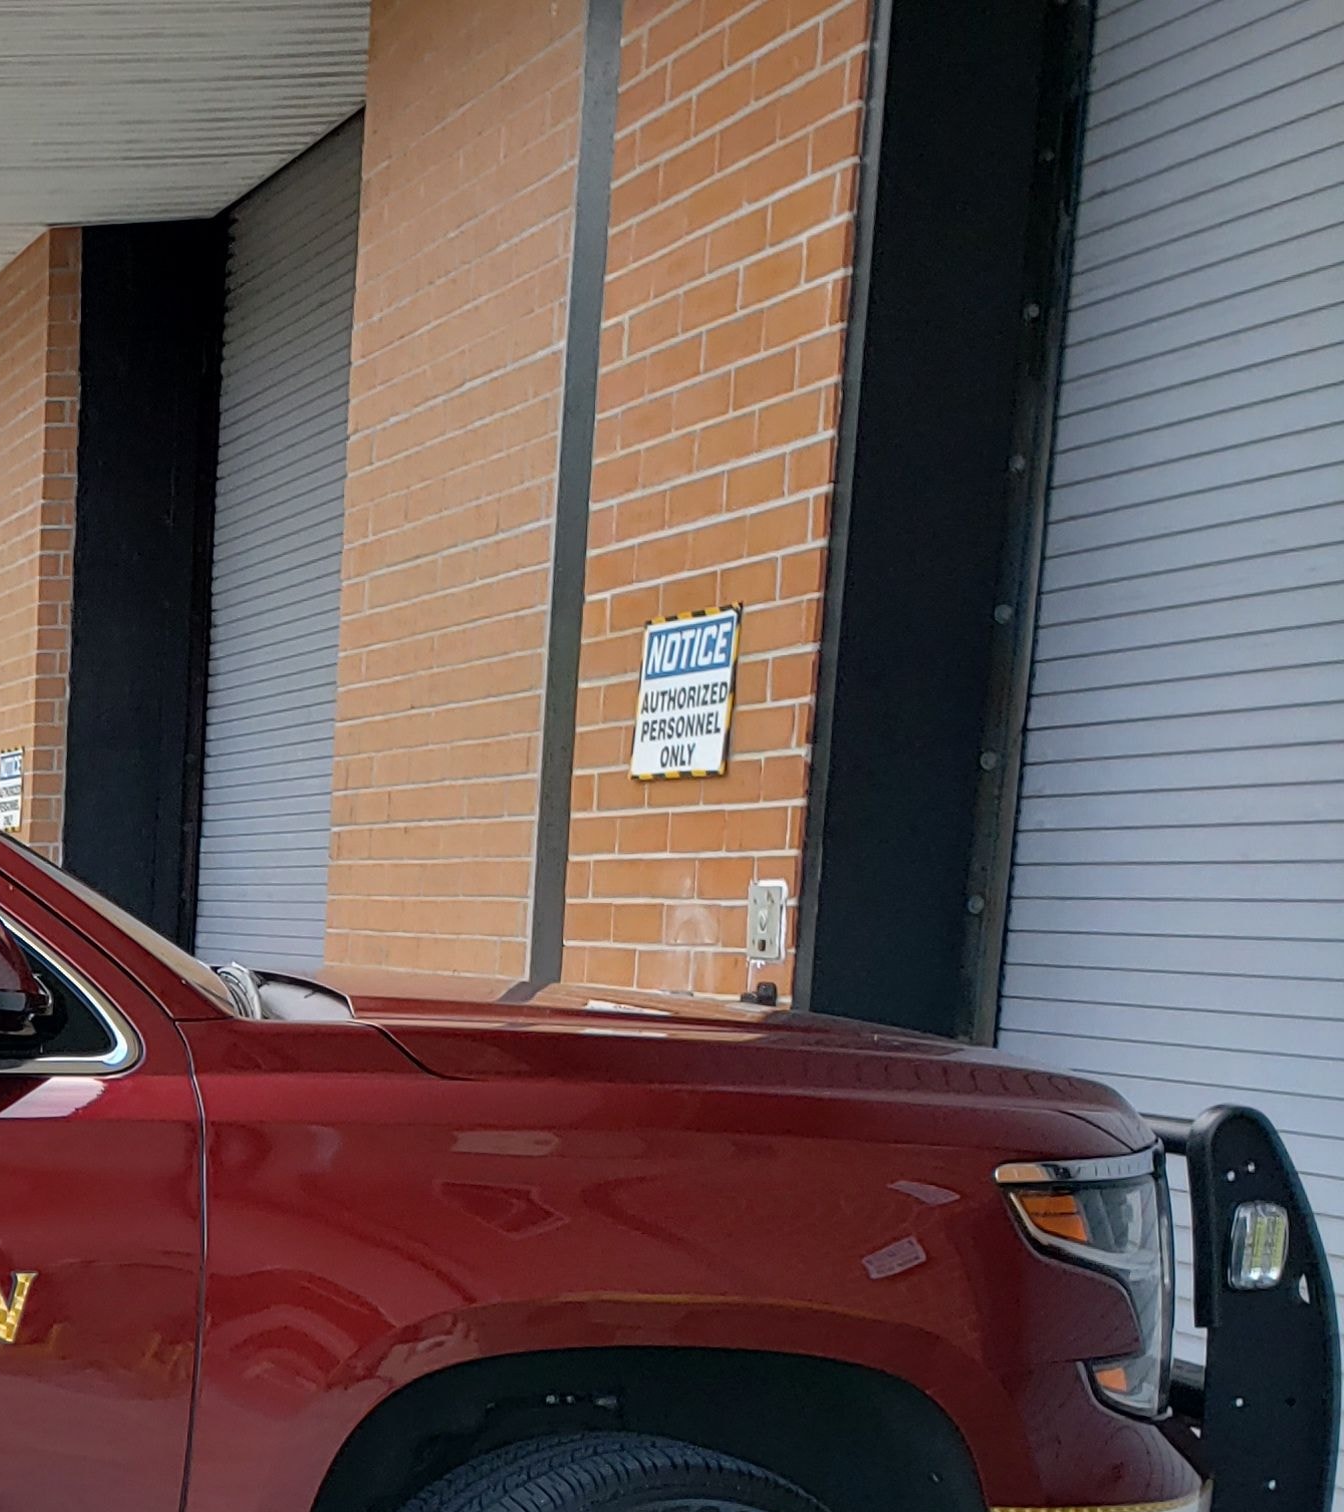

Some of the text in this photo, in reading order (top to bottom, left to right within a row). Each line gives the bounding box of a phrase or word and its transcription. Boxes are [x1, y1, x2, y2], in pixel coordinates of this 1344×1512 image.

[647, 621, 733, 676] NOTICE
[640, 680, 728, 715] AUTHORIZED
[640, 711, 721, 743] PERSONNEL
[659, 742, 697, 769] ONLY
